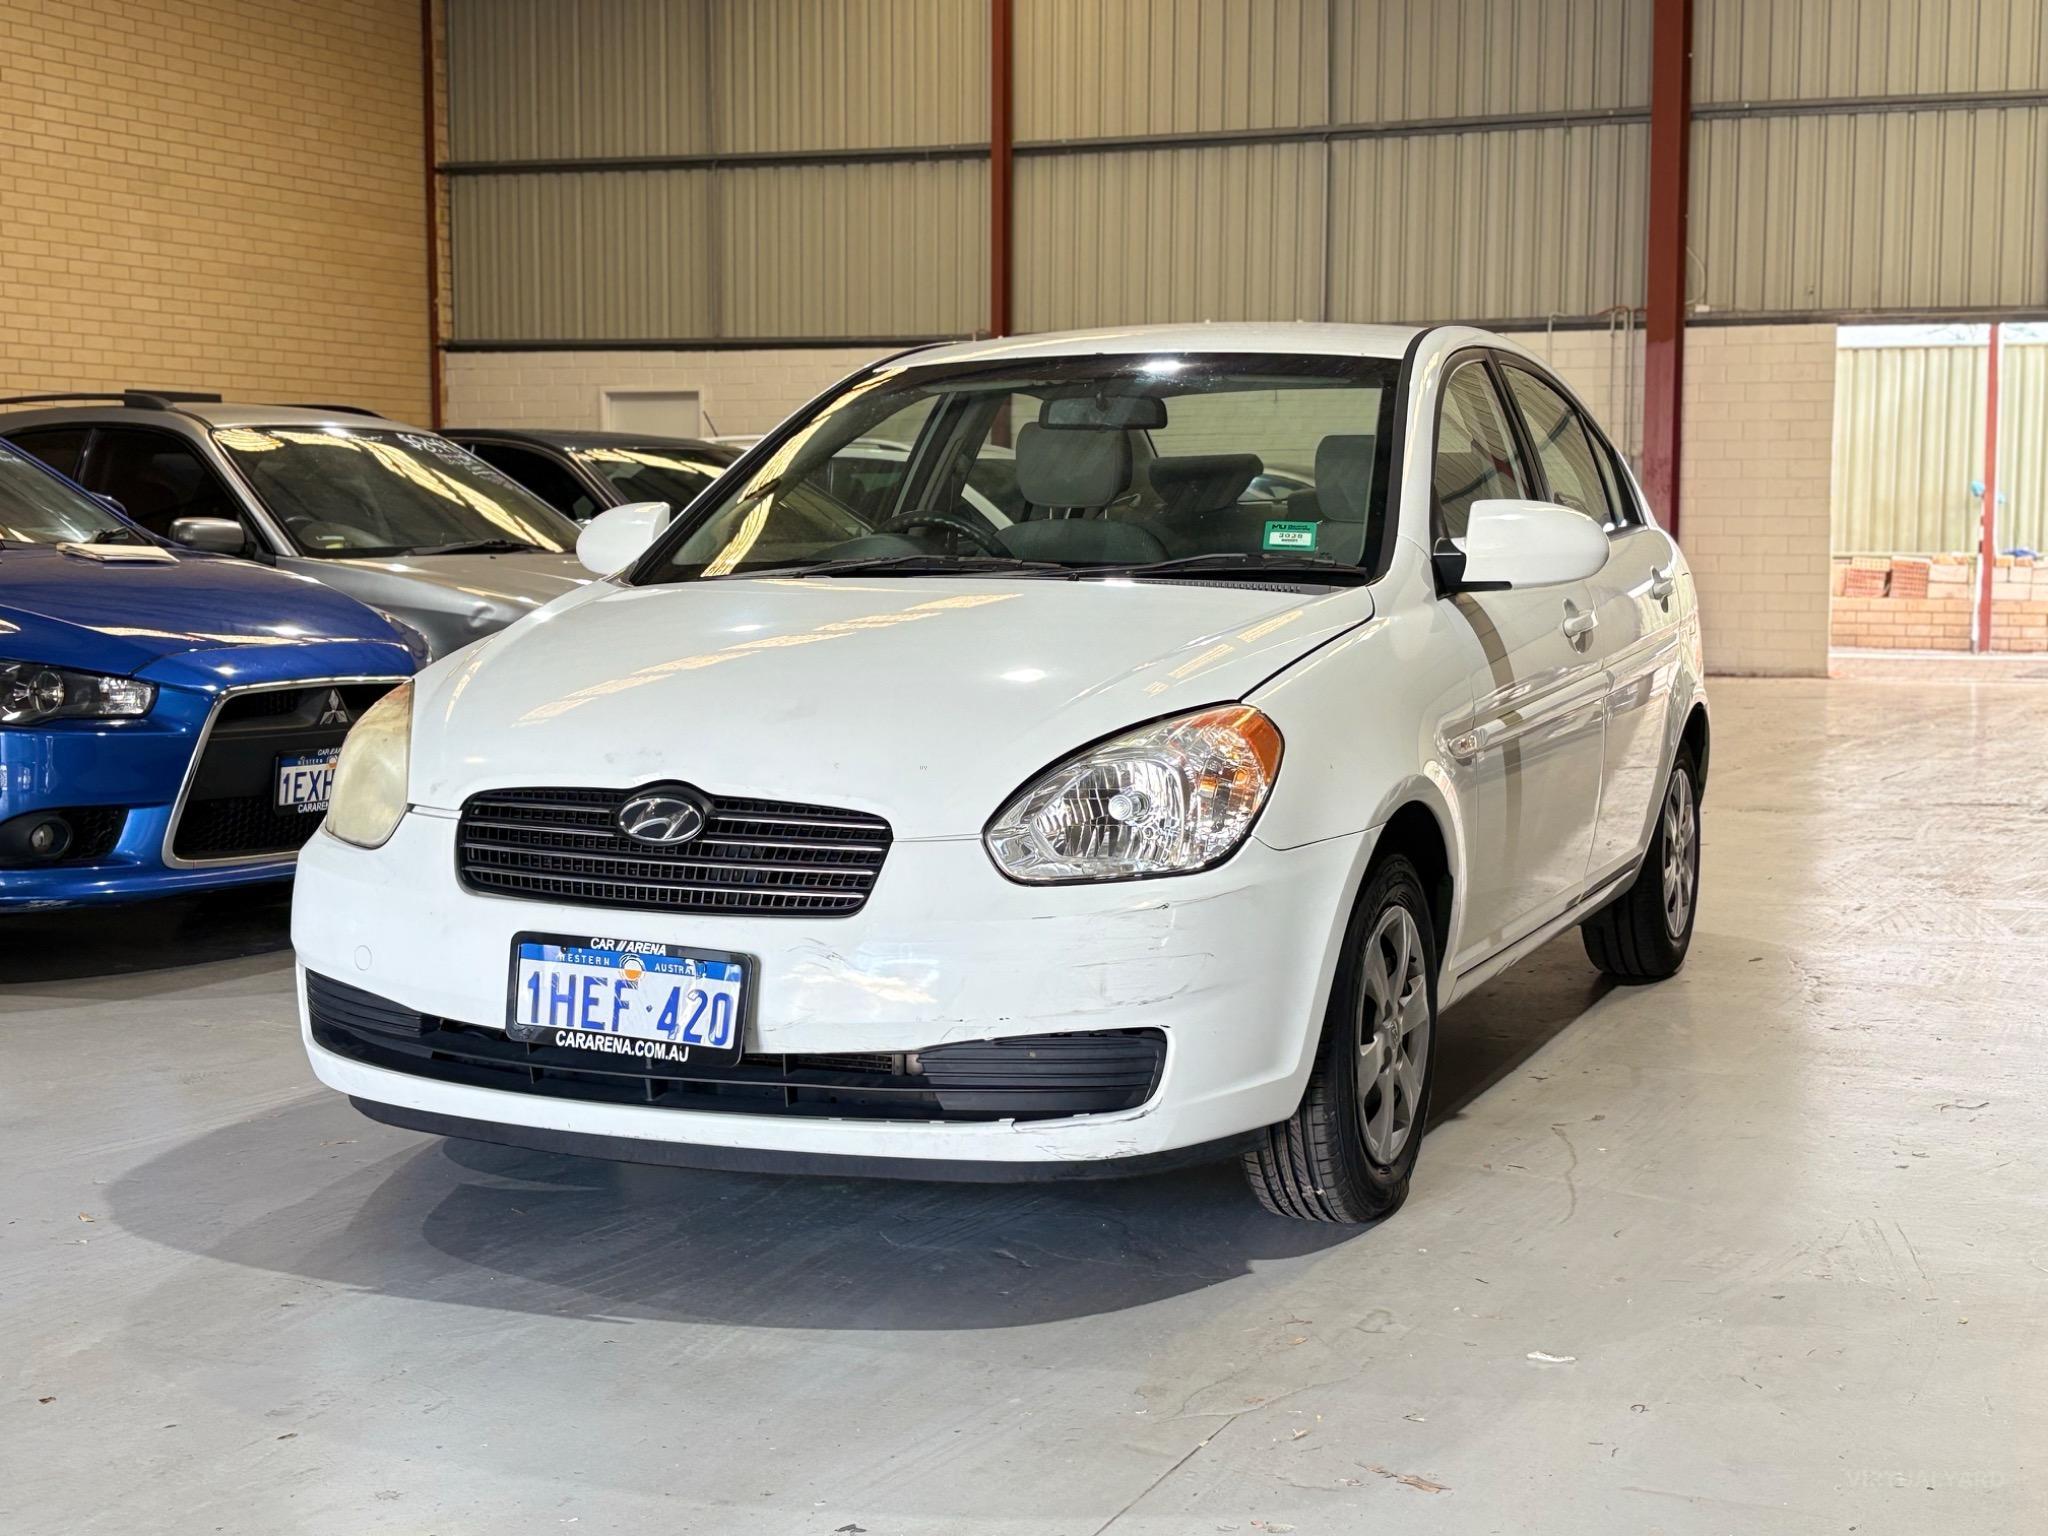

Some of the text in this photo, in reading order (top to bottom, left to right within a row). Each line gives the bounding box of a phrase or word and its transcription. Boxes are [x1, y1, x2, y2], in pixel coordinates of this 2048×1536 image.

[283, 769, 336, 804] 1EXH
[590, 937, 615, 951] CAR
[527, 971, 730, 1047] 1HEF 420
[555, 1030, 690, 1063] CARARENA.COM.AU
